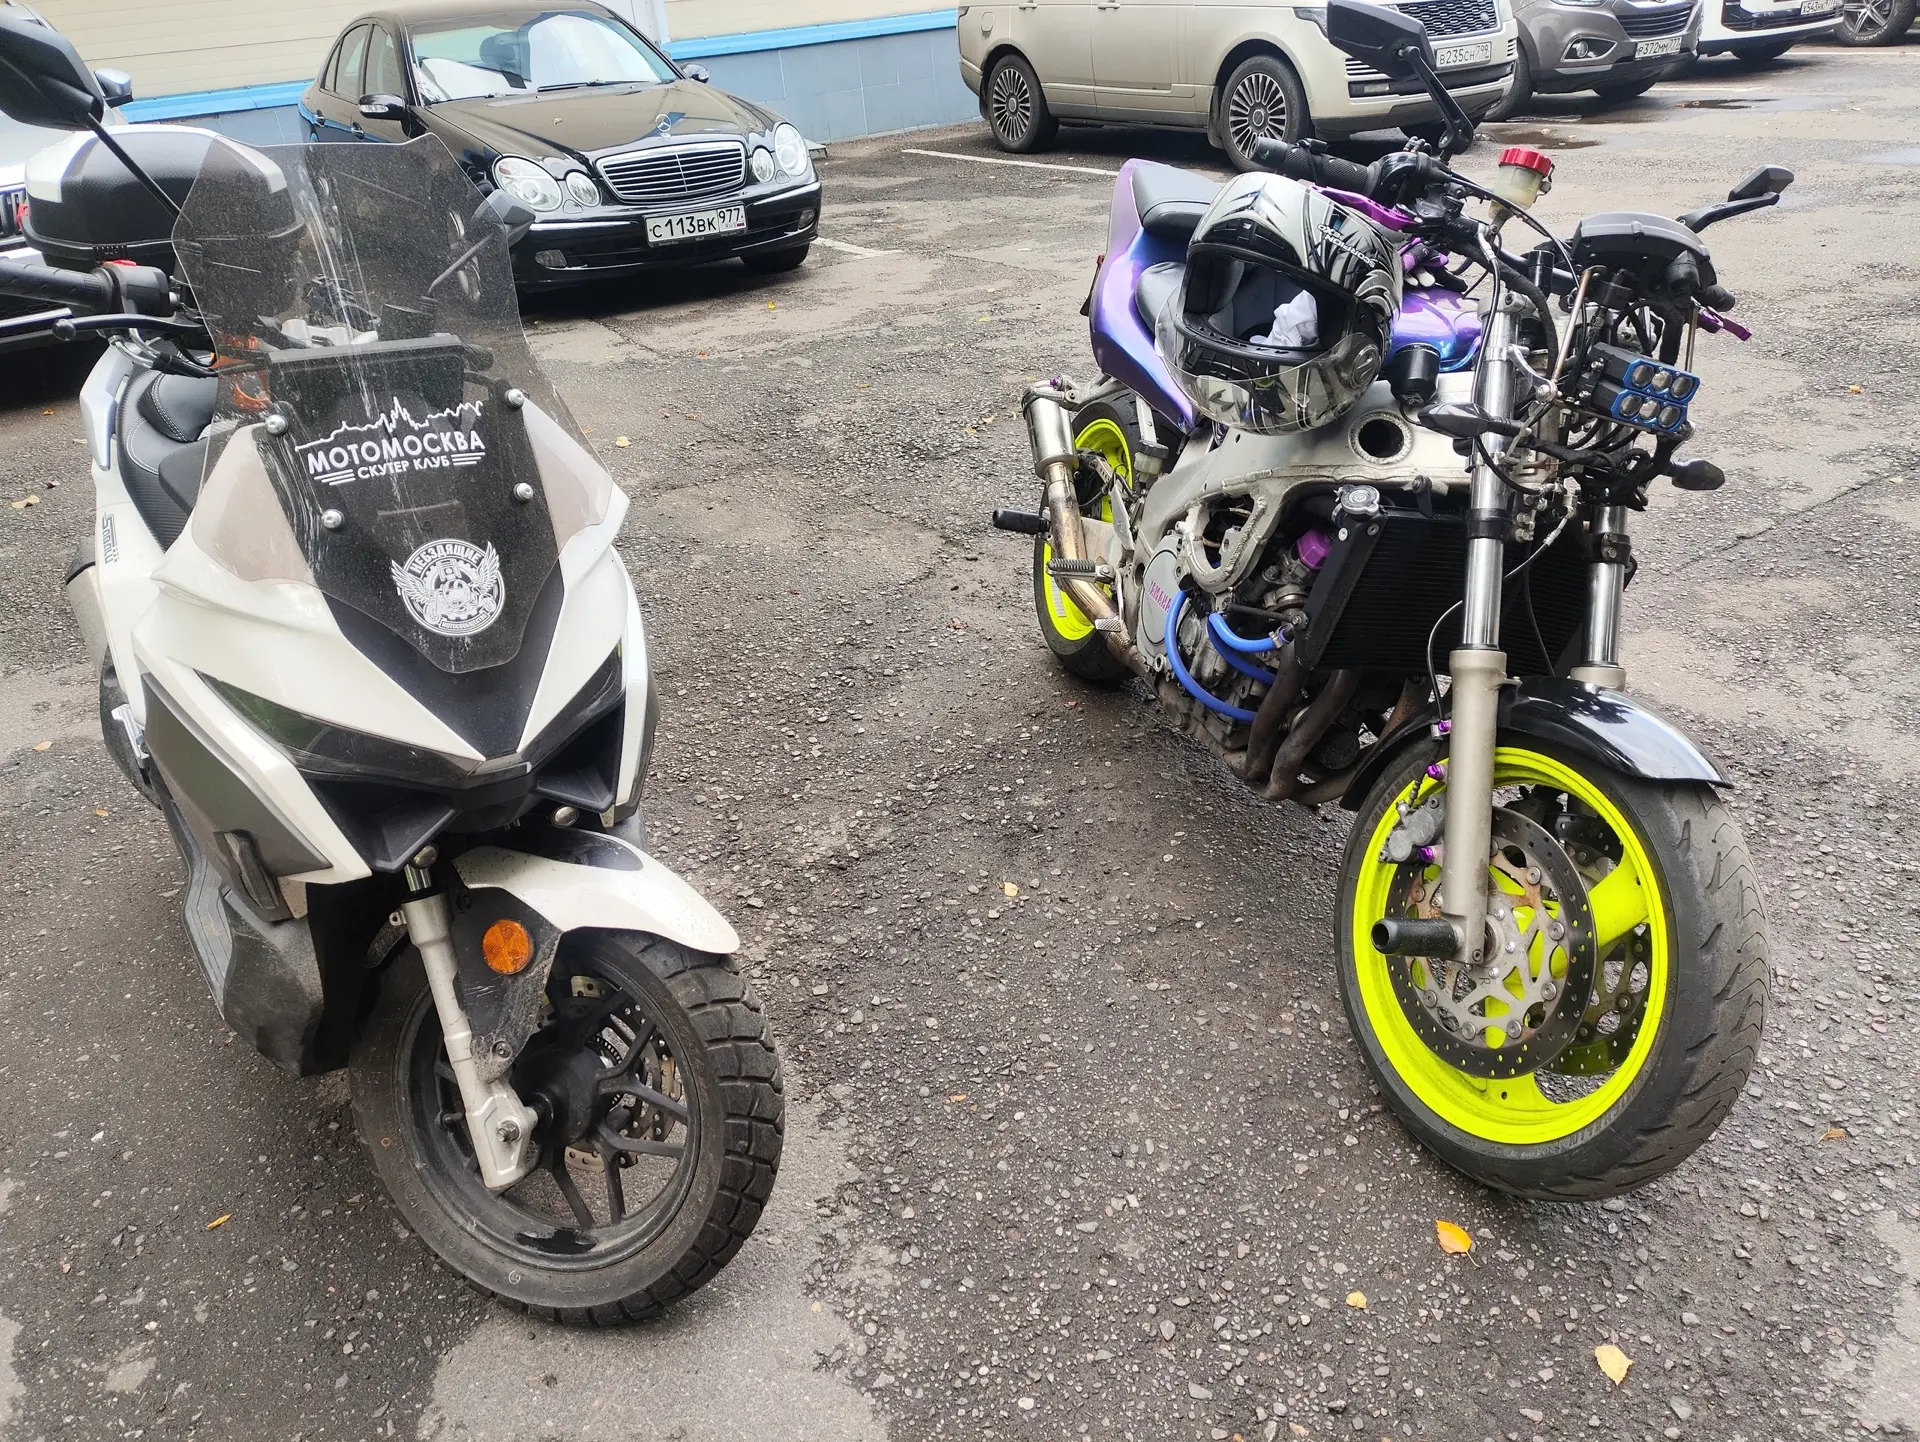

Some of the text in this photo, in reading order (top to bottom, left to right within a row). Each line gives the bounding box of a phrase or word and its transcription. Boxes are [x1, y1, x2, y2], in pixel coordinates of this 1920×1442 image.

[1440, 44, 1489, 65] В235СН 799
[652, 207, 741, 238] С113ВК 977
[1325, 233, 1376, 268] SCORPION
[307, 430, 486, 474] МОТОМОСКВА
[357, 455, 450, 479] СКУТЕР КЛУБ
[409, 544, 483, 574] НЕБЗДЯЩИЕ
